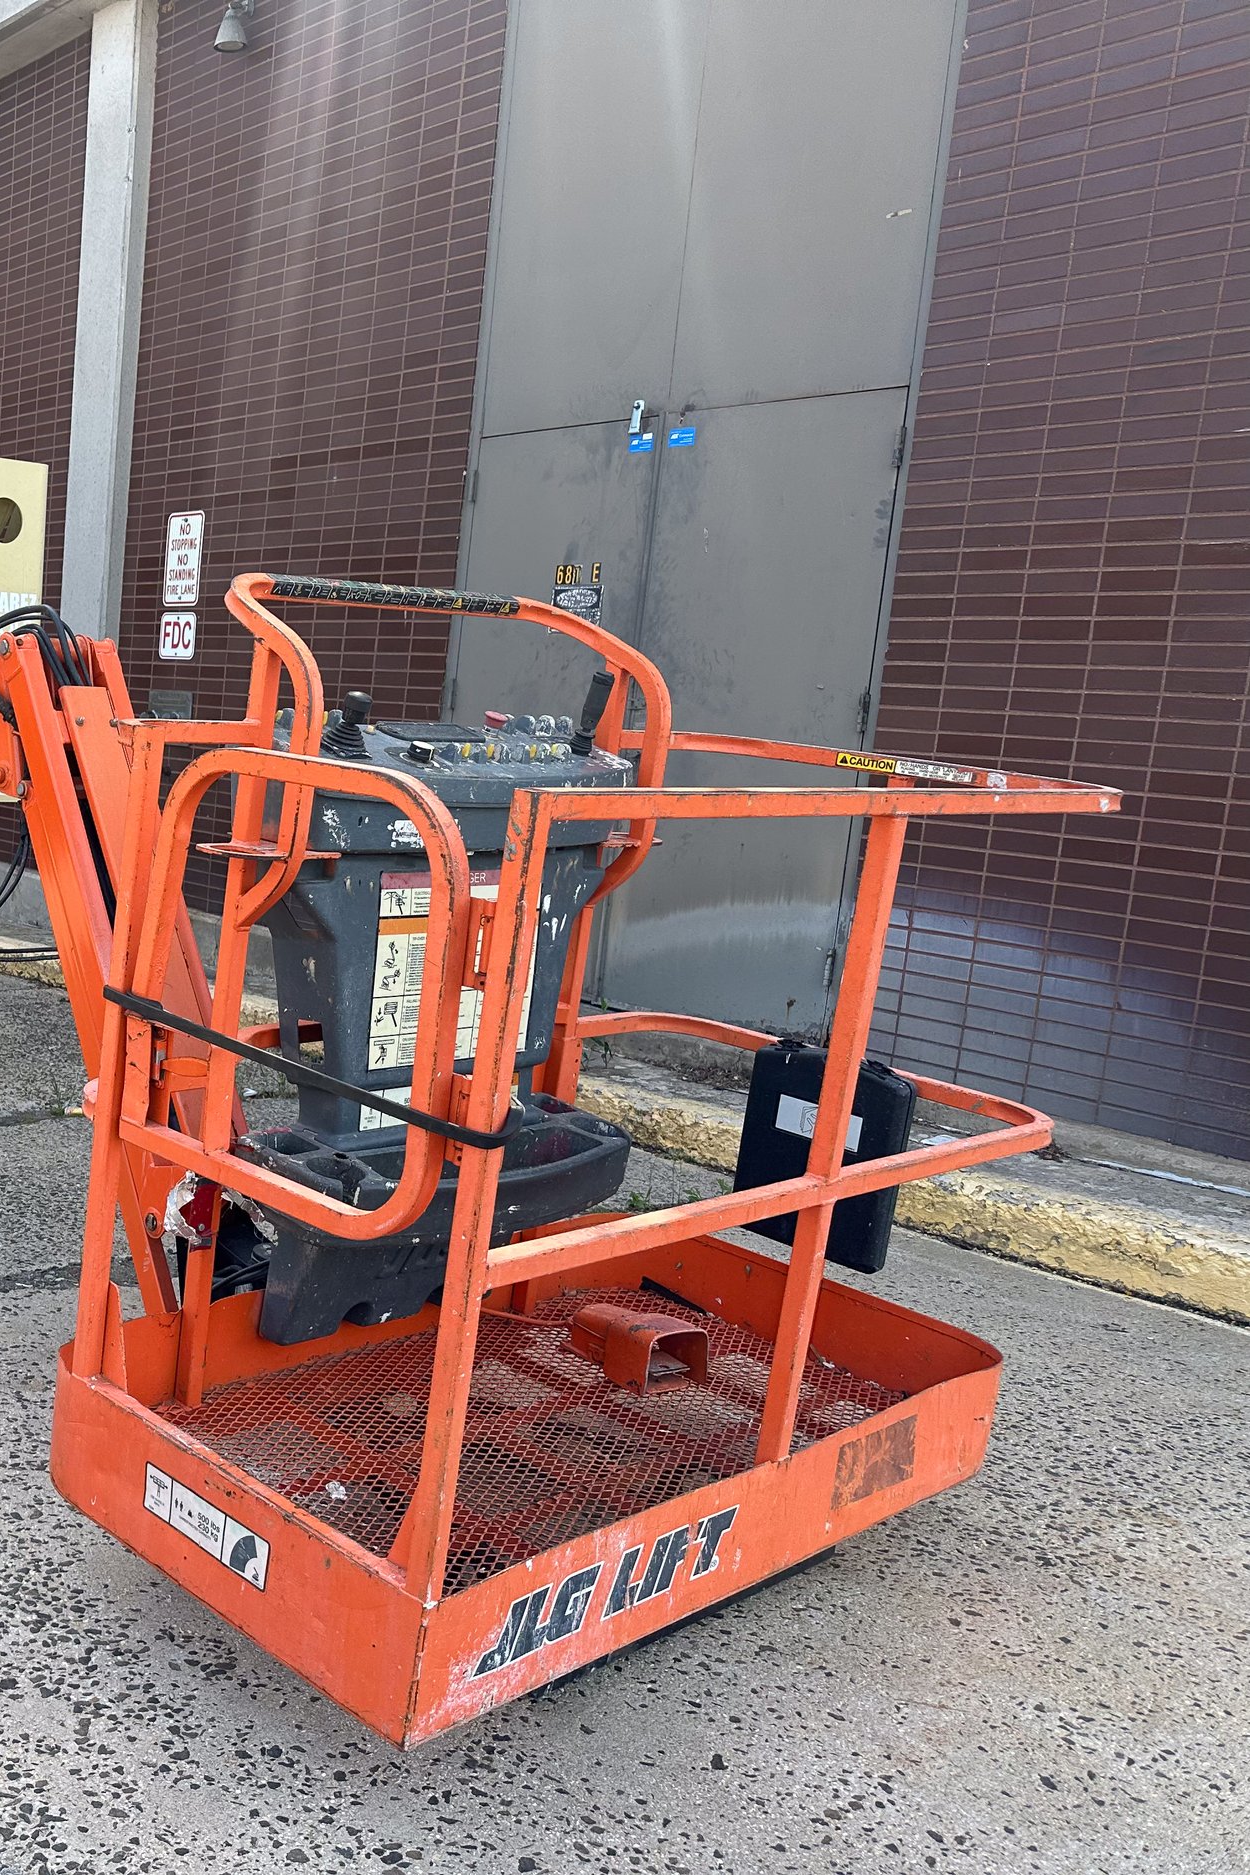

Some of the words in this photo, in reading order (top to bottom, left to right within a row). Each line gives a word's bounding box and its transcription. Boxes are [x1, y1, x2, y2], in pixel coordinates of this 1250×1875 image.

[179, 523, 191, 536] NO
[171, 537, 198, 551] STOPPING
[177, 554, 189, 566] NO
[168, 568, 195, 581] STANDING
[592, 563, 600, 582] E
[166, 585, 179, 596] FIRE
[181, 584, 195, 595] LANE
[162, 620, 192, 649] FDC
[849, 756, 894, 770] CAUTION
[197, 1512, 210, 1525] 500
[210, 1520, 220, 1533] lbs
[197, 1520, 210, 1534] 230
[210, 1529, 219, 1542] kg
[469, 1561, 604, 1680] JLG
[601, 1504, 740, 1621] LIFT
